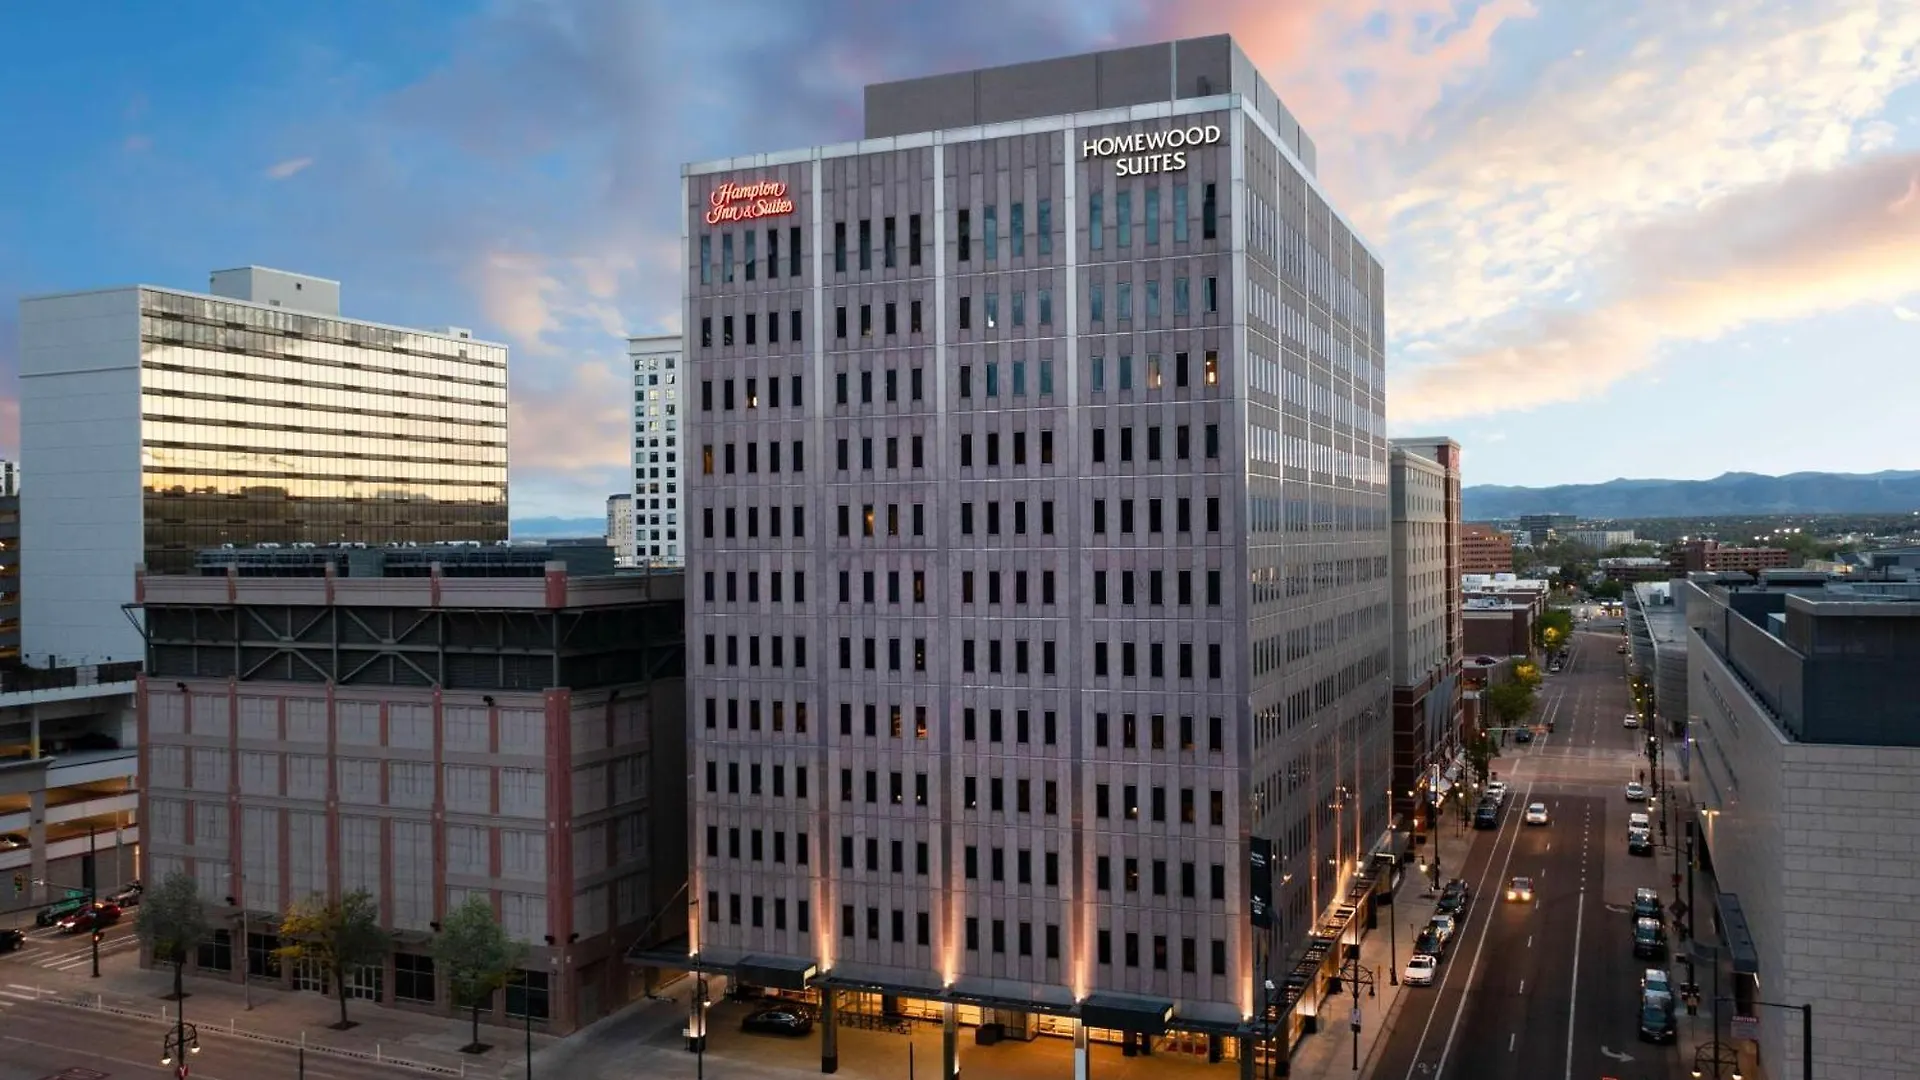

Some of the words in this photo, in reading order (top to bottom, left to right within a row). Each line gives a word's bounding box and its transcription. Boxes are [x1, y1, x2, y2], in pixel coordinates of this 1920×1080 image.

[1083, 125, 1221, 157] HOMEWOOD
[1116, 152, 1186, 176] SUITES
[711, 181, 786, 206] Hampton
[706, 204, 743, 224] Inn
[752, 198, 793, 216] Suites
